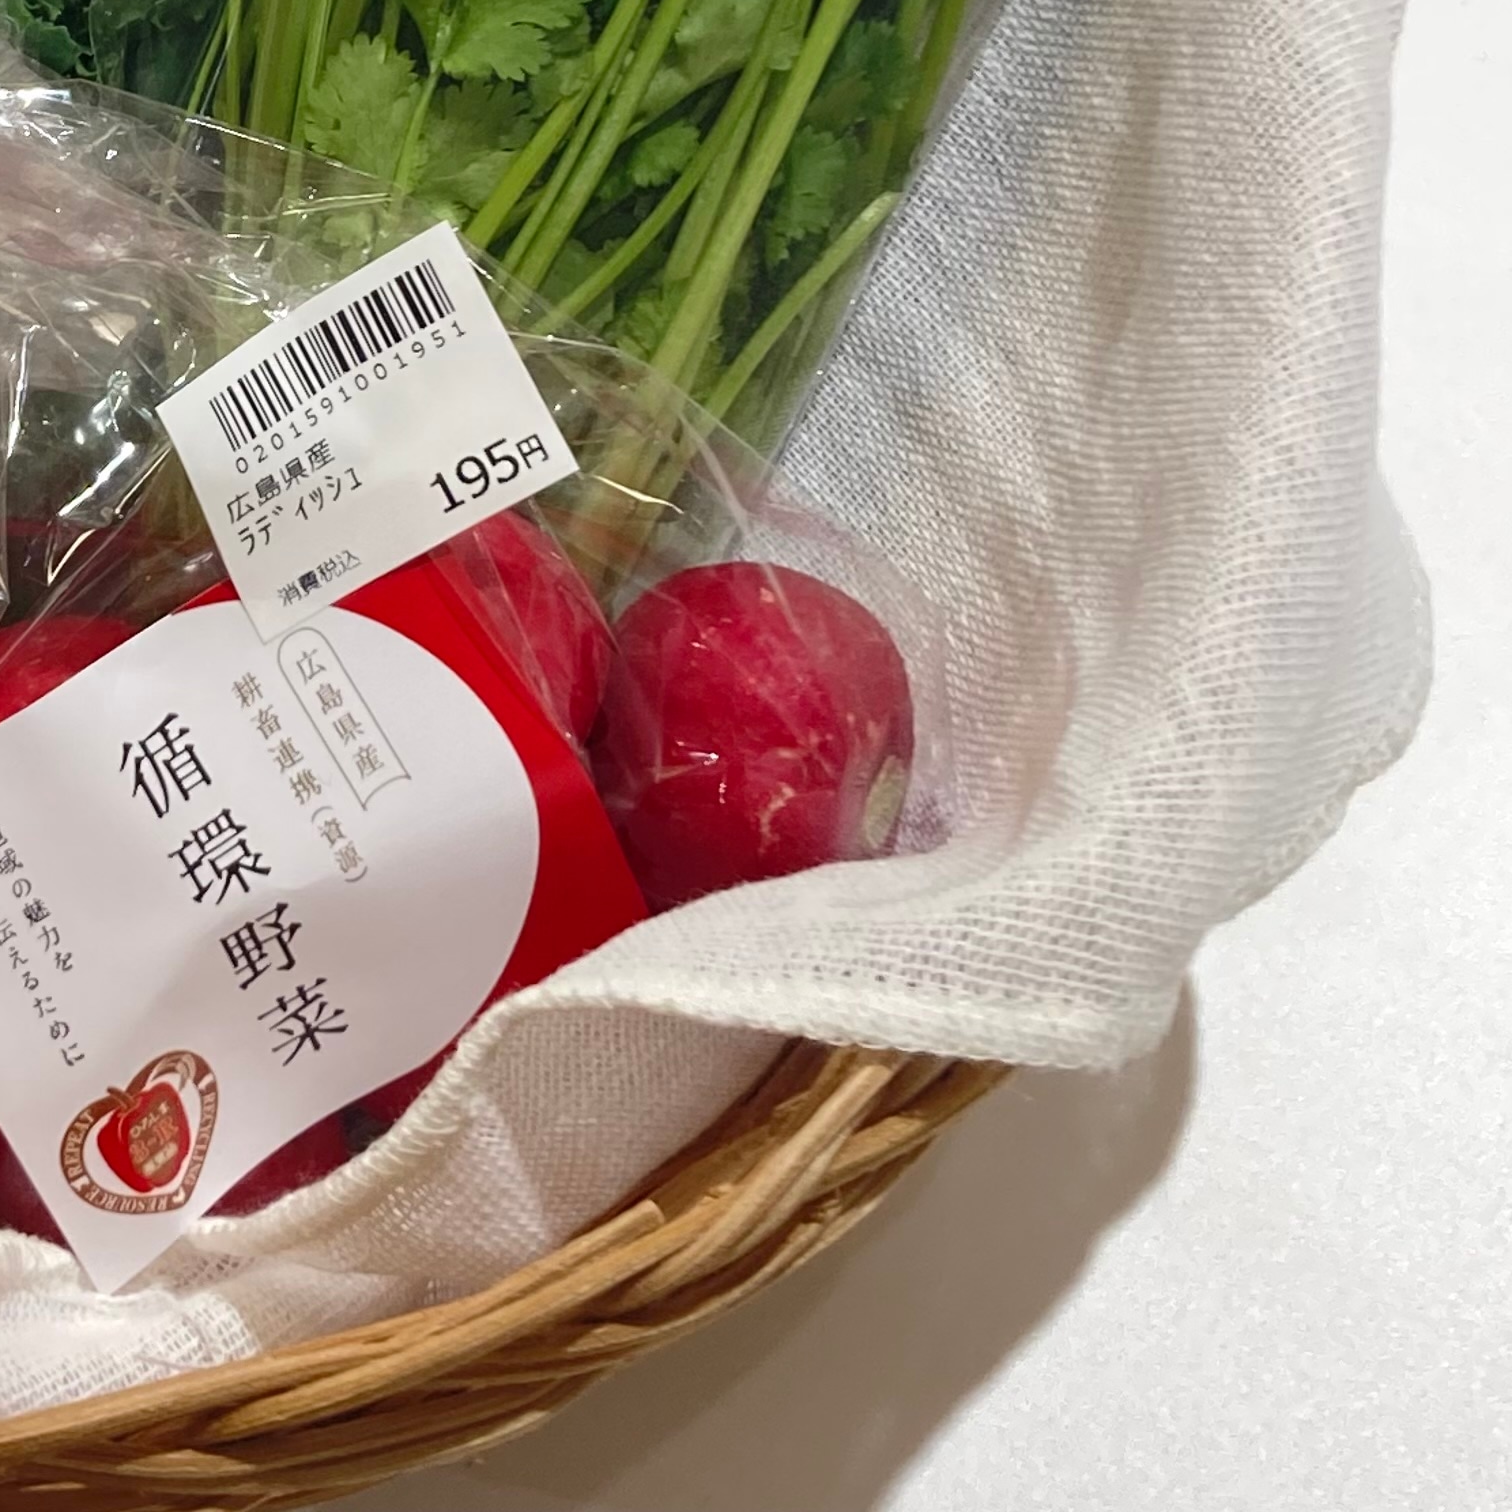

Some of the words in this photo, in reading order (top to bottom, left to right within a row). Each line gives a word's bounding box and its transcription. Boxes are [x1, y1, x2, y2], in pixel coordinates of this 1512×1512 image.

[234, 319, 467, 476] 0201591001951
[226, 437, 336, 526] 広島県産
[429, 433, 551, 514] 195円
[277, 549, 362, 607] 消費税込
[296, 648, 385, 781] 広島県産
[118, 711, 351, 1068] 循環野菜
[64, 1108, 95, 1180] REPEAT
[85, 1186, 168, 1212] RESOURCE
